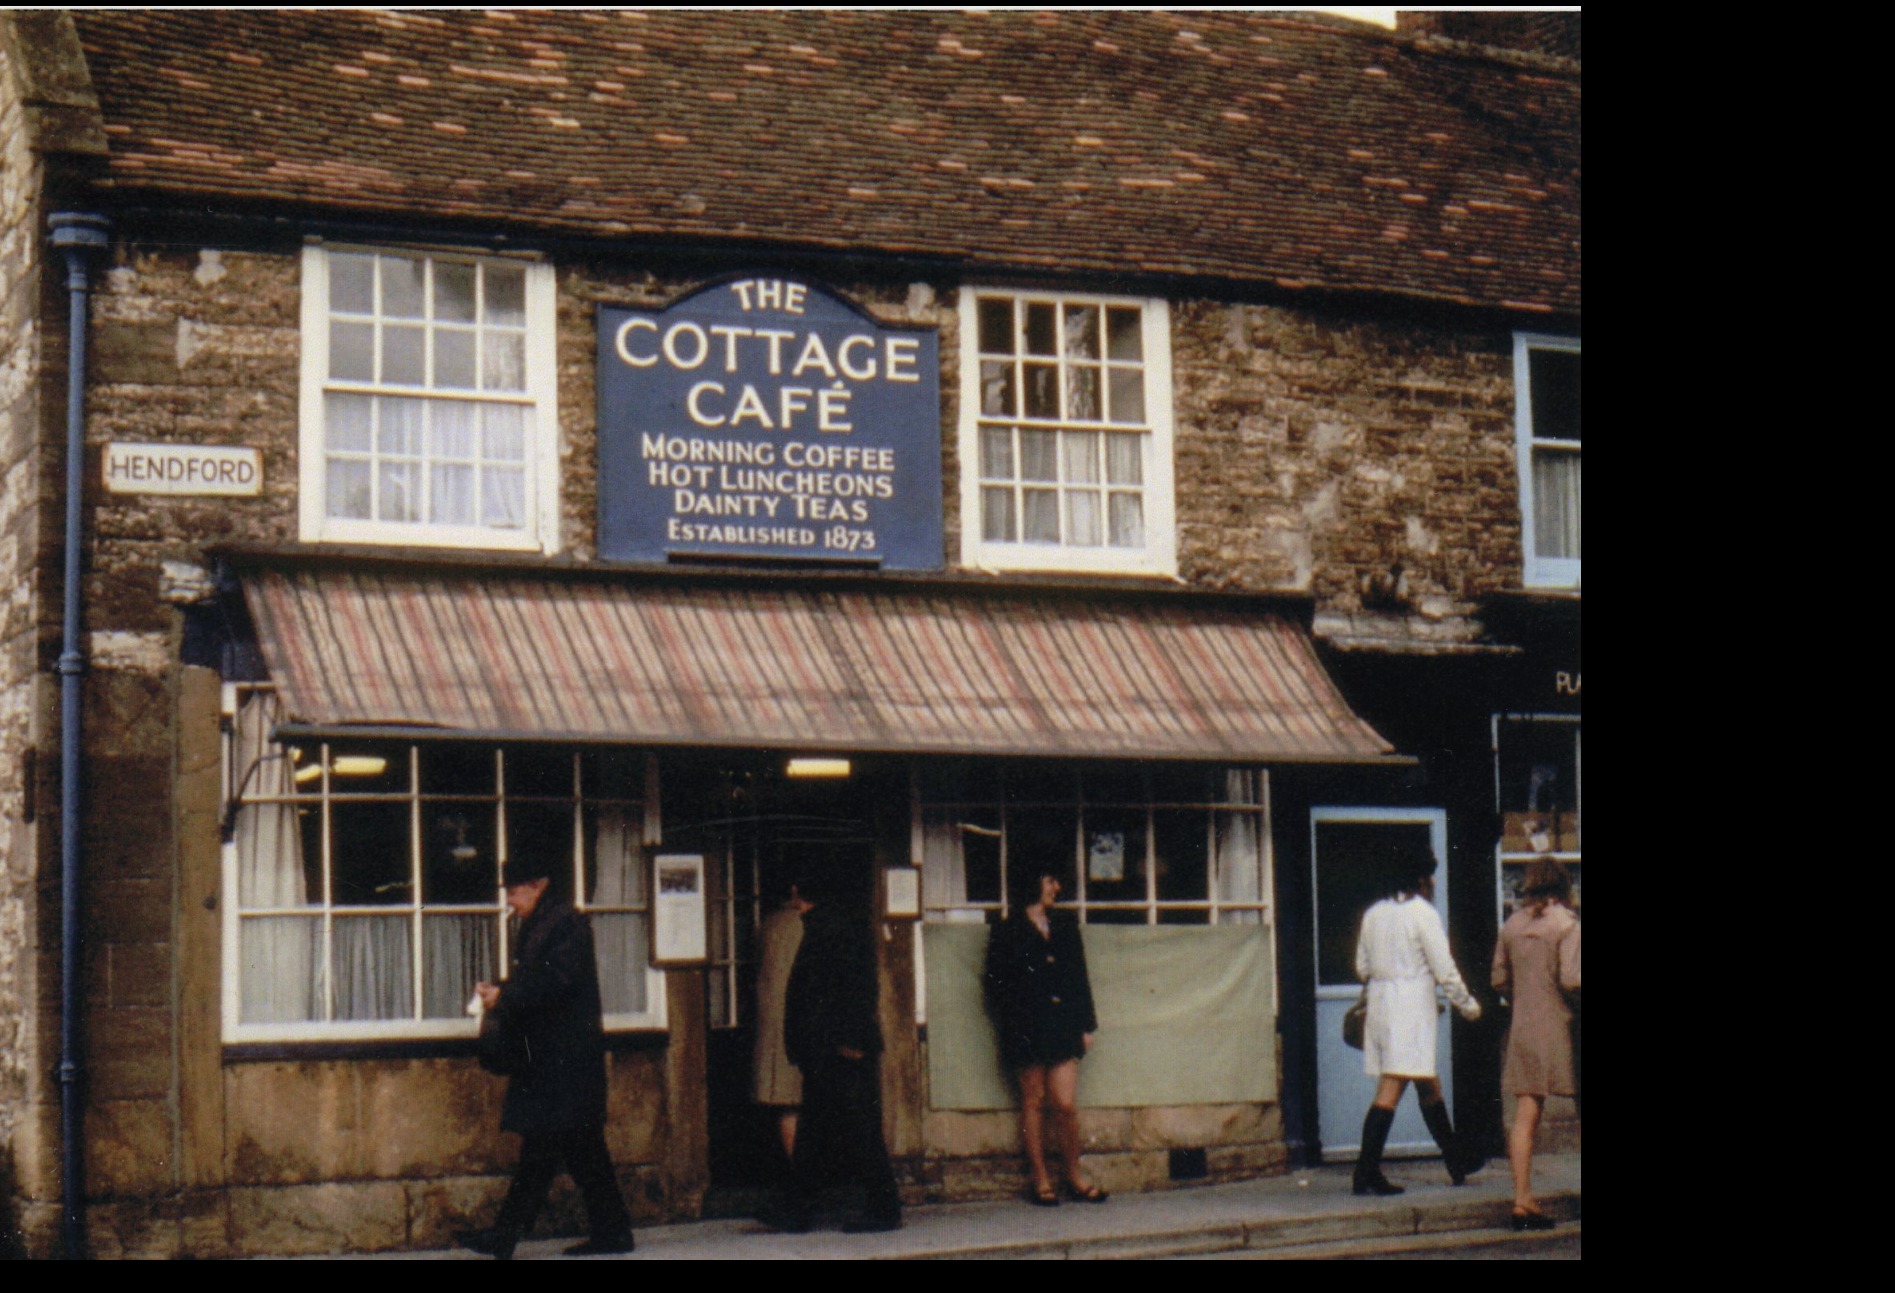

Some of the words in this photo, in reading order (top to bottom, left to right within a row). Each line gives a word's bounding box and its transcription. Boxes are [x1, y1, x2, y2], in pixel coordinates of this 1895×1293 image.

[731, 279, 807, 313] THE
[614, 316, 920, 382] COTTAGE
[686, 380, 853, 431] CAFÉ
[110, 455, 254, 484] HENDFORD
[648, 462, 713, 487] HOT
[823, 526, 876, 550] 1873
